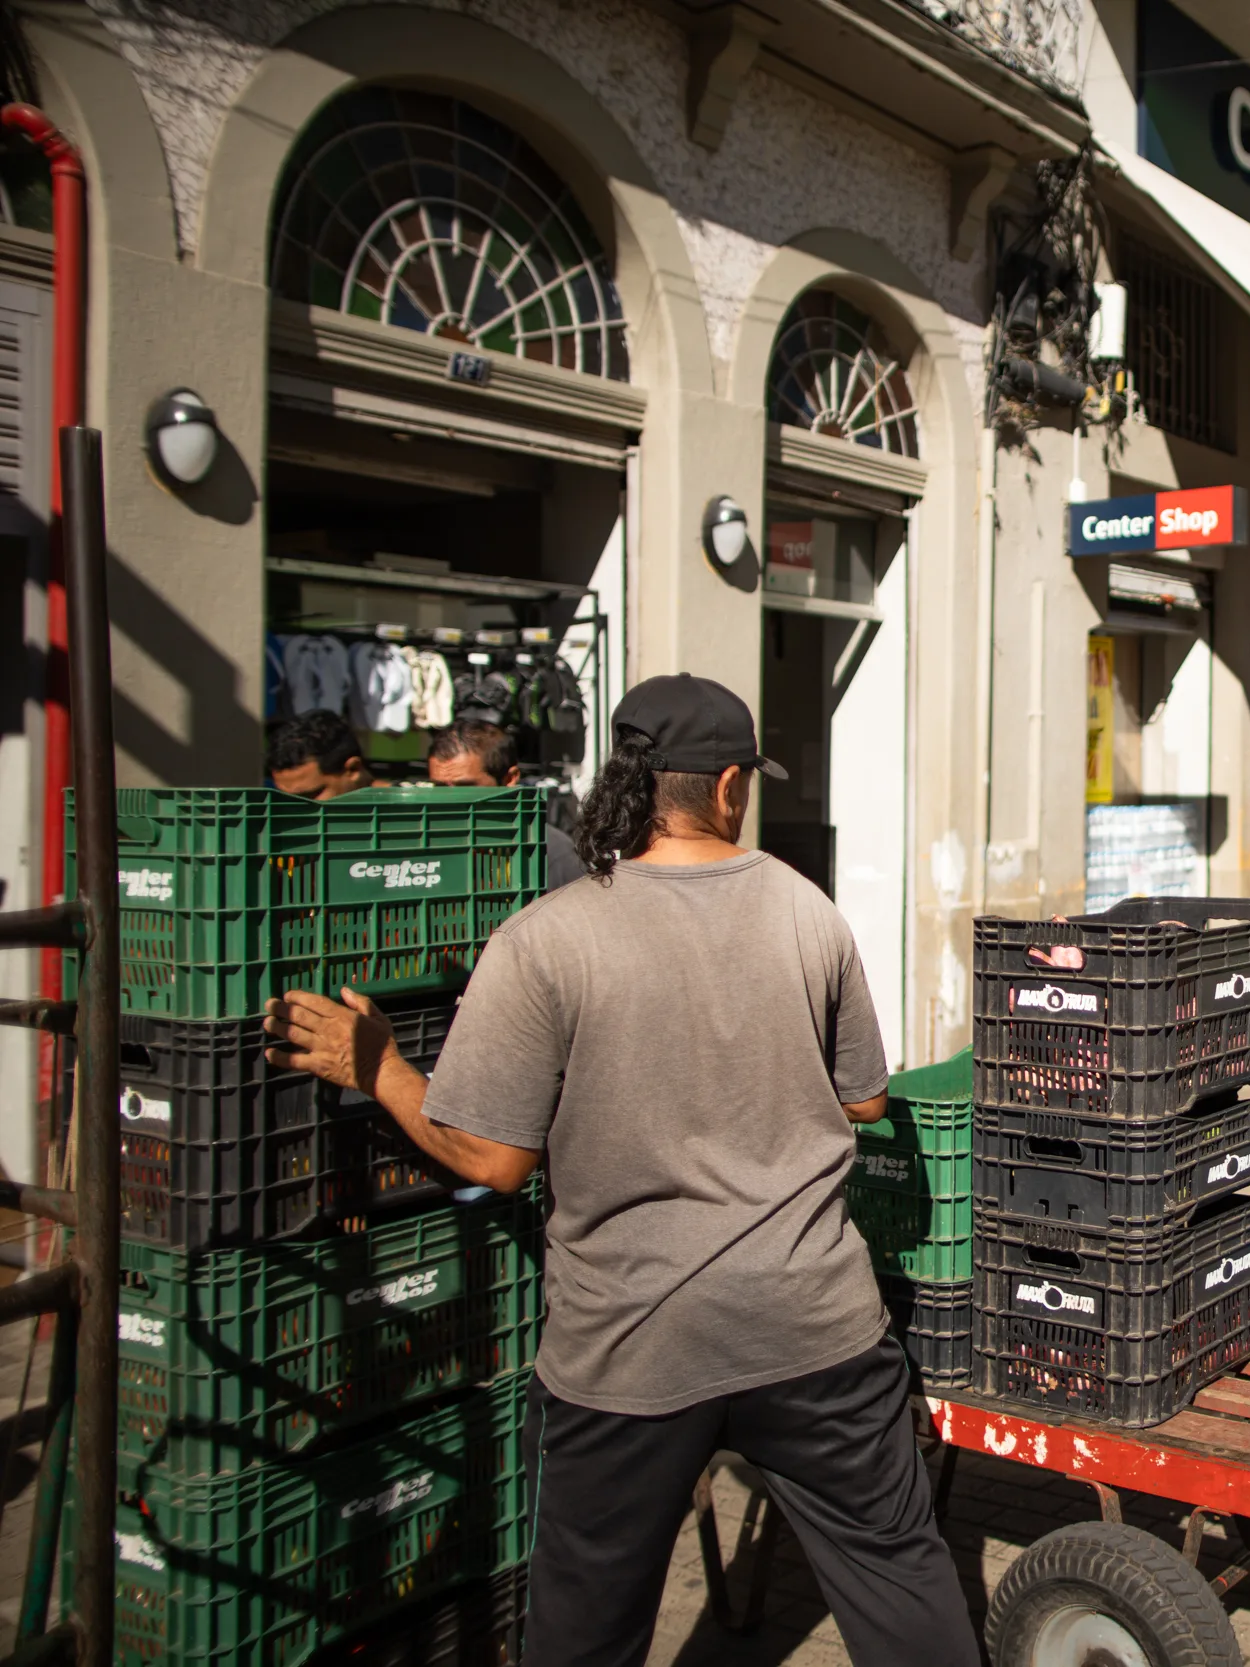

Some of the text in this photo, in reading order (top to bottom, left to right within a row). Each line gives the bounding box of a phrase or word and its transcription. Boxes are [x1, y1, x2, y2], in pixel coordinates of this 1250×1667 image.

[456, 355, 484, 382] 121
[1082, 508, 1218, 541] Center Shop
[118, 869, 173, 886] enter
[349, 860, 441, 878] Center
[1063, 993, 1097, 1012] FRUTA
[855, 1154, 908, 1169] enter
[346, 1268, 438, 1306] Center
[1061, 1293, 1095, 1314] FRUTA
